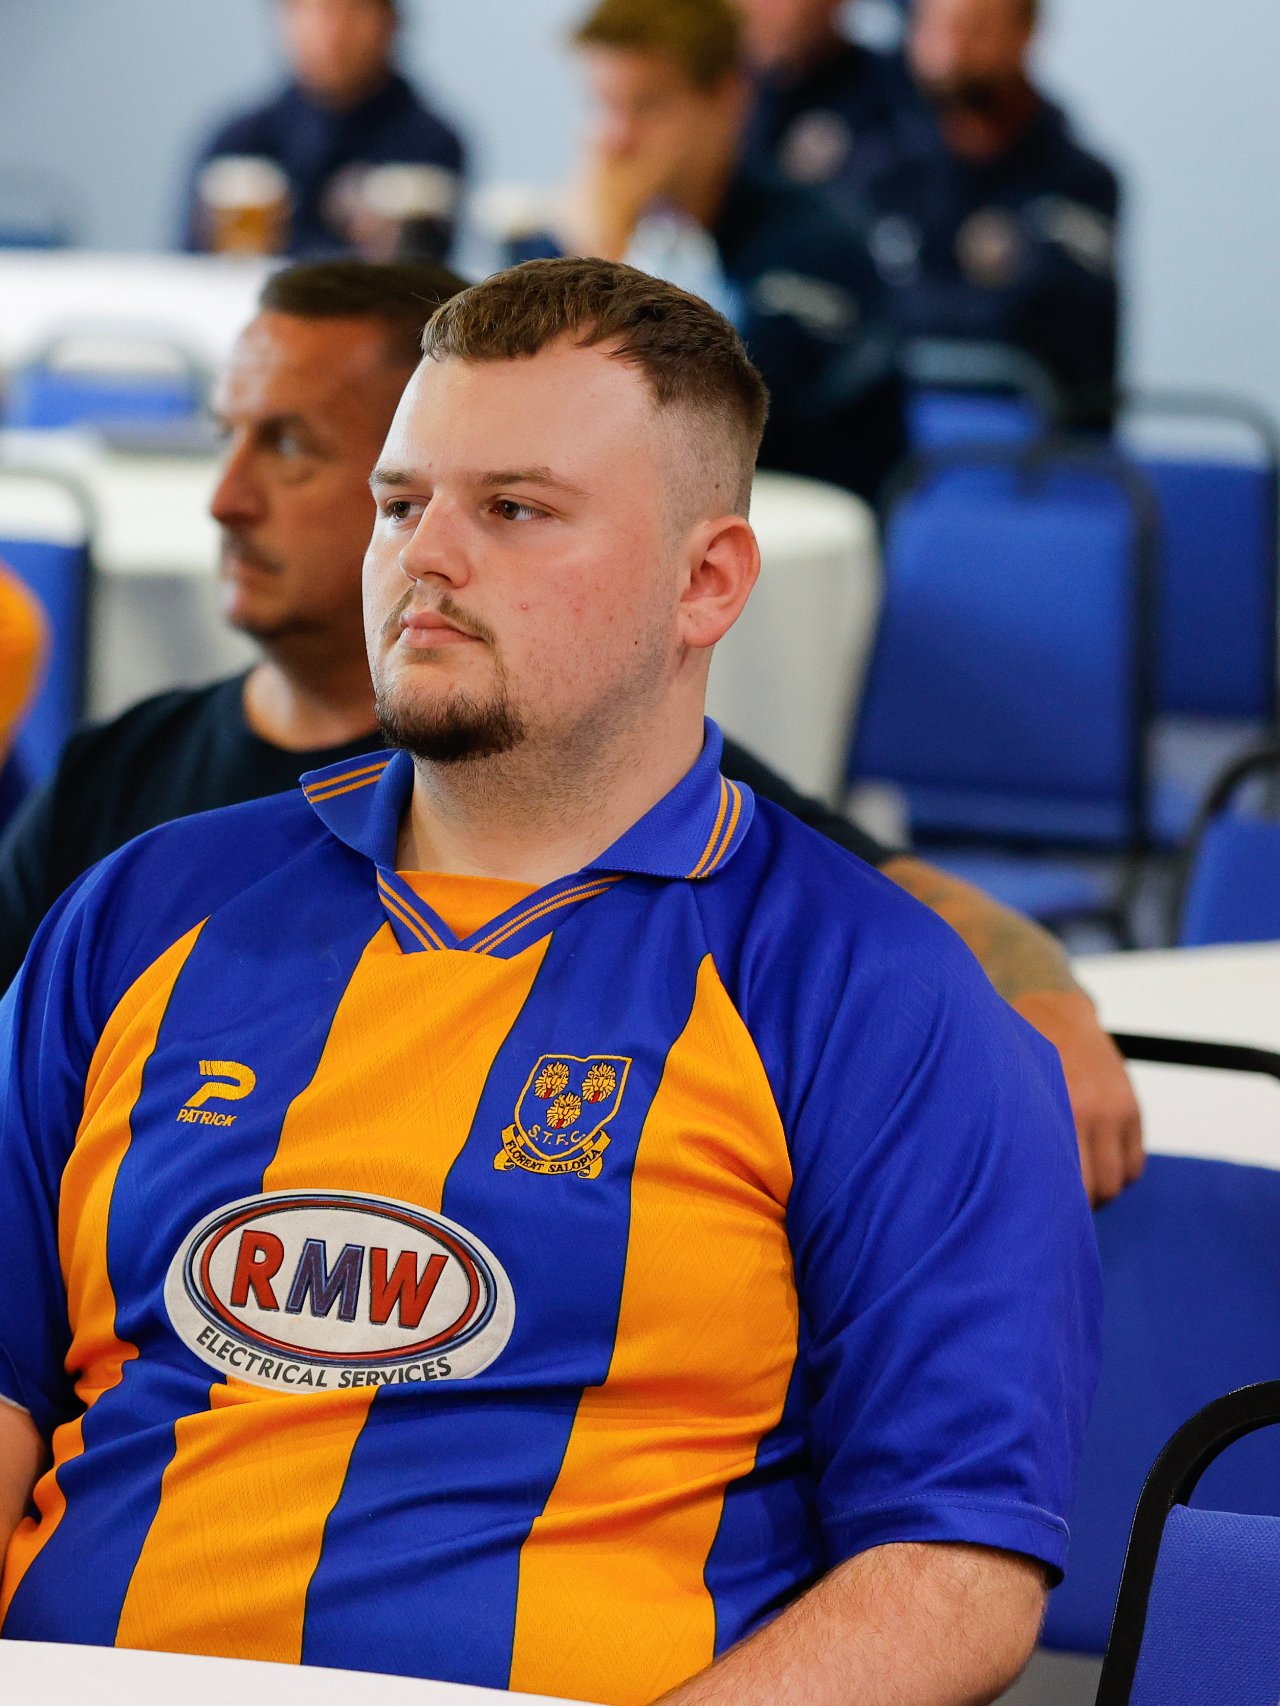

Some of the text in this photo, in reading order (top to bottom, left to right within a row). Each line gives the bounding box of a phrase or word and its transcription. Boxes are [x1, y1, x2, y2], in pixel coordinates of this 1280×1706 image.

[176, 1108, 238, 1127] PATRICK
[548, 1149, 602, 1174] SALOPIA
[229, 1229, 450, 1329] RMW
[195, 1325, 453, 1389] ELECTRICAL SERVICES
